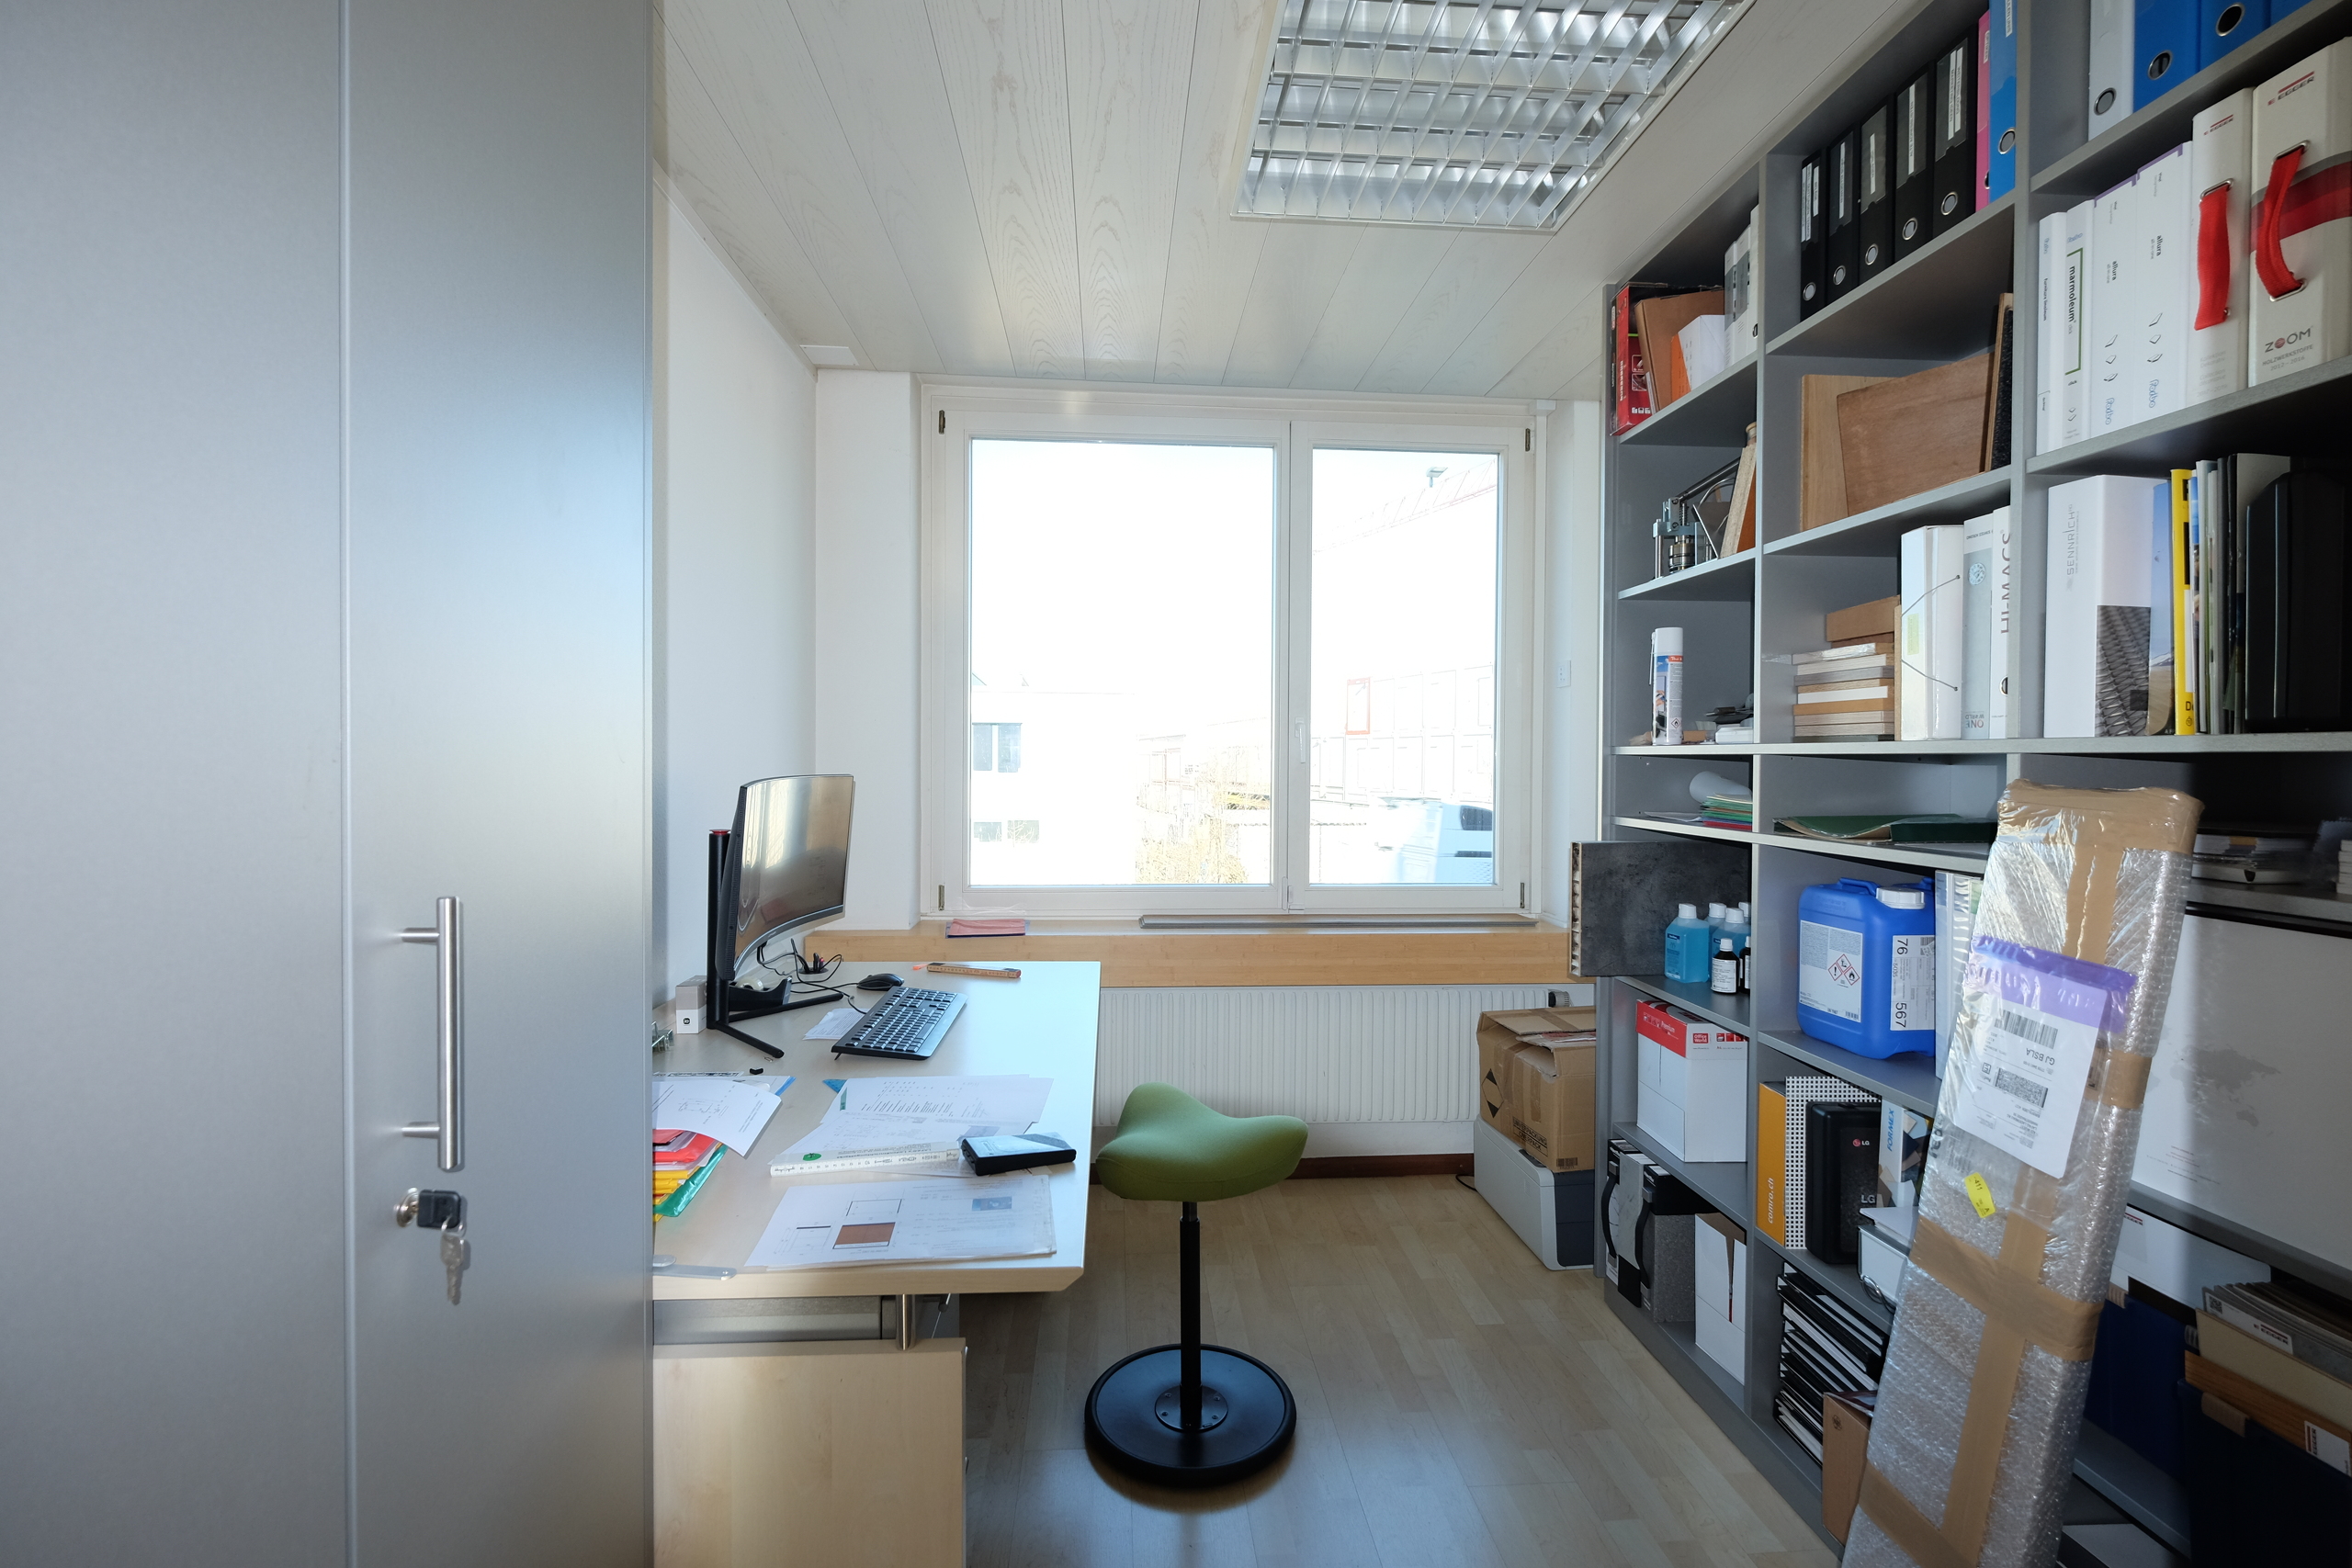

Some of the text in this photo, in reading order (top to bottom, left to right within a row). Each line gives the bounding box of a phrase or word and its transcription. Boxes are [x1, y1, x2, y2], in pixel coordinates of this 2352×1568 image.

[2277, 76, 2315, 101] EGGER
[2210, 118, 2233, 133] EGGER
[2264, 328, 2311, 353] ZOOM
[2262, 344, 2313, 366] HOLZWERKSTOFFE
[2062, 511, 2075, 575] SENNRICH
[1965, 720, 1984, 728] ONE
[1897, 938, 1908, 955] 76
[1895, 1002, 1907, 1028] 567
[2026, 1047, 2055, 1066] GJ BSLA
[1886, 1108, 1895, 1152] FORMEX
[1861, 1195, 1876, 1204] LG
[2261, 1327, 2289, 1345] EGGER
